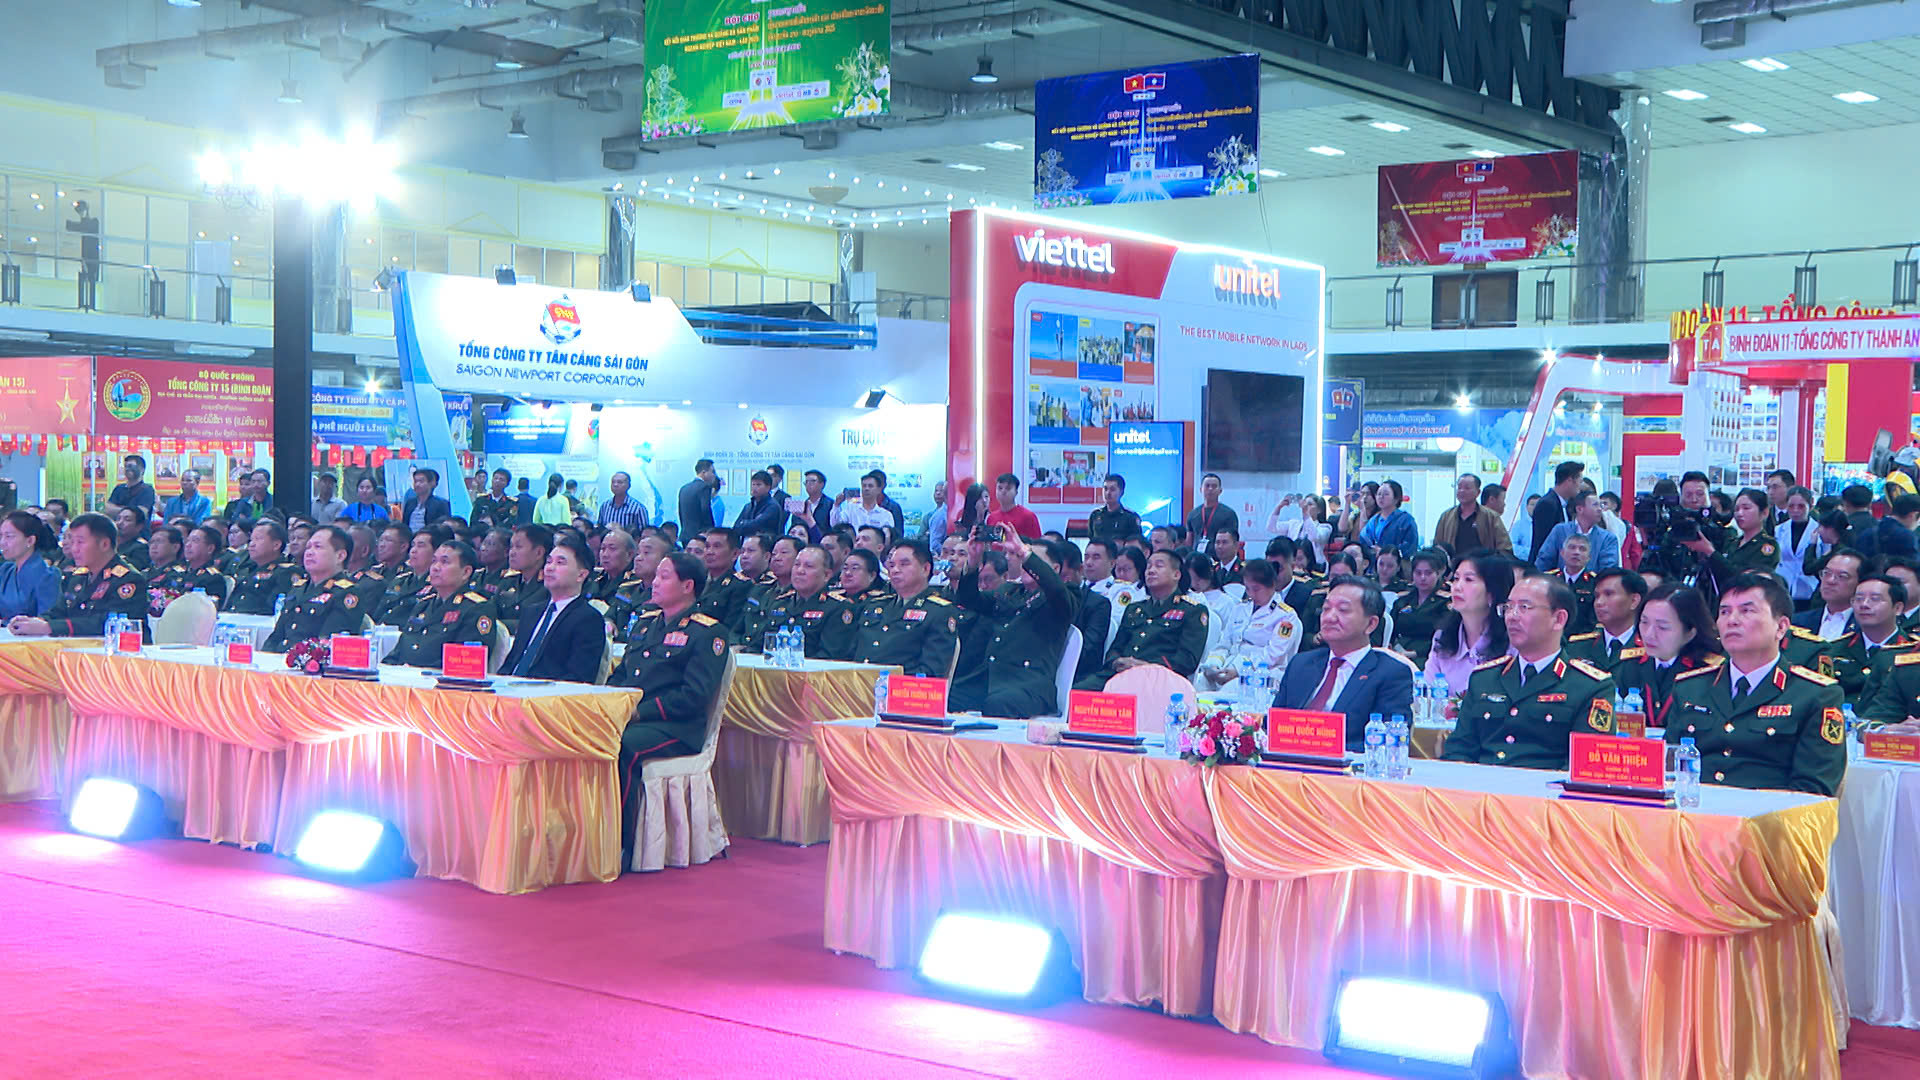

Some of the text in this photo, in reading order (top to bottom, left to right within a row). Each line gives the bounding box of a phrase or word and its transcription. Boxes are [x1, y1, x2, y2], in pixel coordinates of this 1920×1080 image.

[1013, 228, 1116, 274] viettel
[1213, 258, 1282, 299] unitel
[554, 307, 575, 320] SNP
[1180, 325, 1308, 352] THE BEST MOBILE NETWORK IN LAOS
[1821, 327, 1848, 350] CÔNG
[1850, 329, 1864, 350] TY
[1867, 325, 1903, 349] THÀNH
[458, 340, 649, 372] TỔNG CÔNG TY TÂN CẢNG SÀI GÒN
[168, 375, 187, 390] TỔNG
[211, 383, 219, 392] TY
[221, 383, 230, 394] 15
[456, 363, 645, 388] SAIGON NEWPORT CORPORATION
[334, 395, 344, 404] TY
[841, 429, 860, 448] TRỤ
[1113, 427, 1151, 444] unitel
